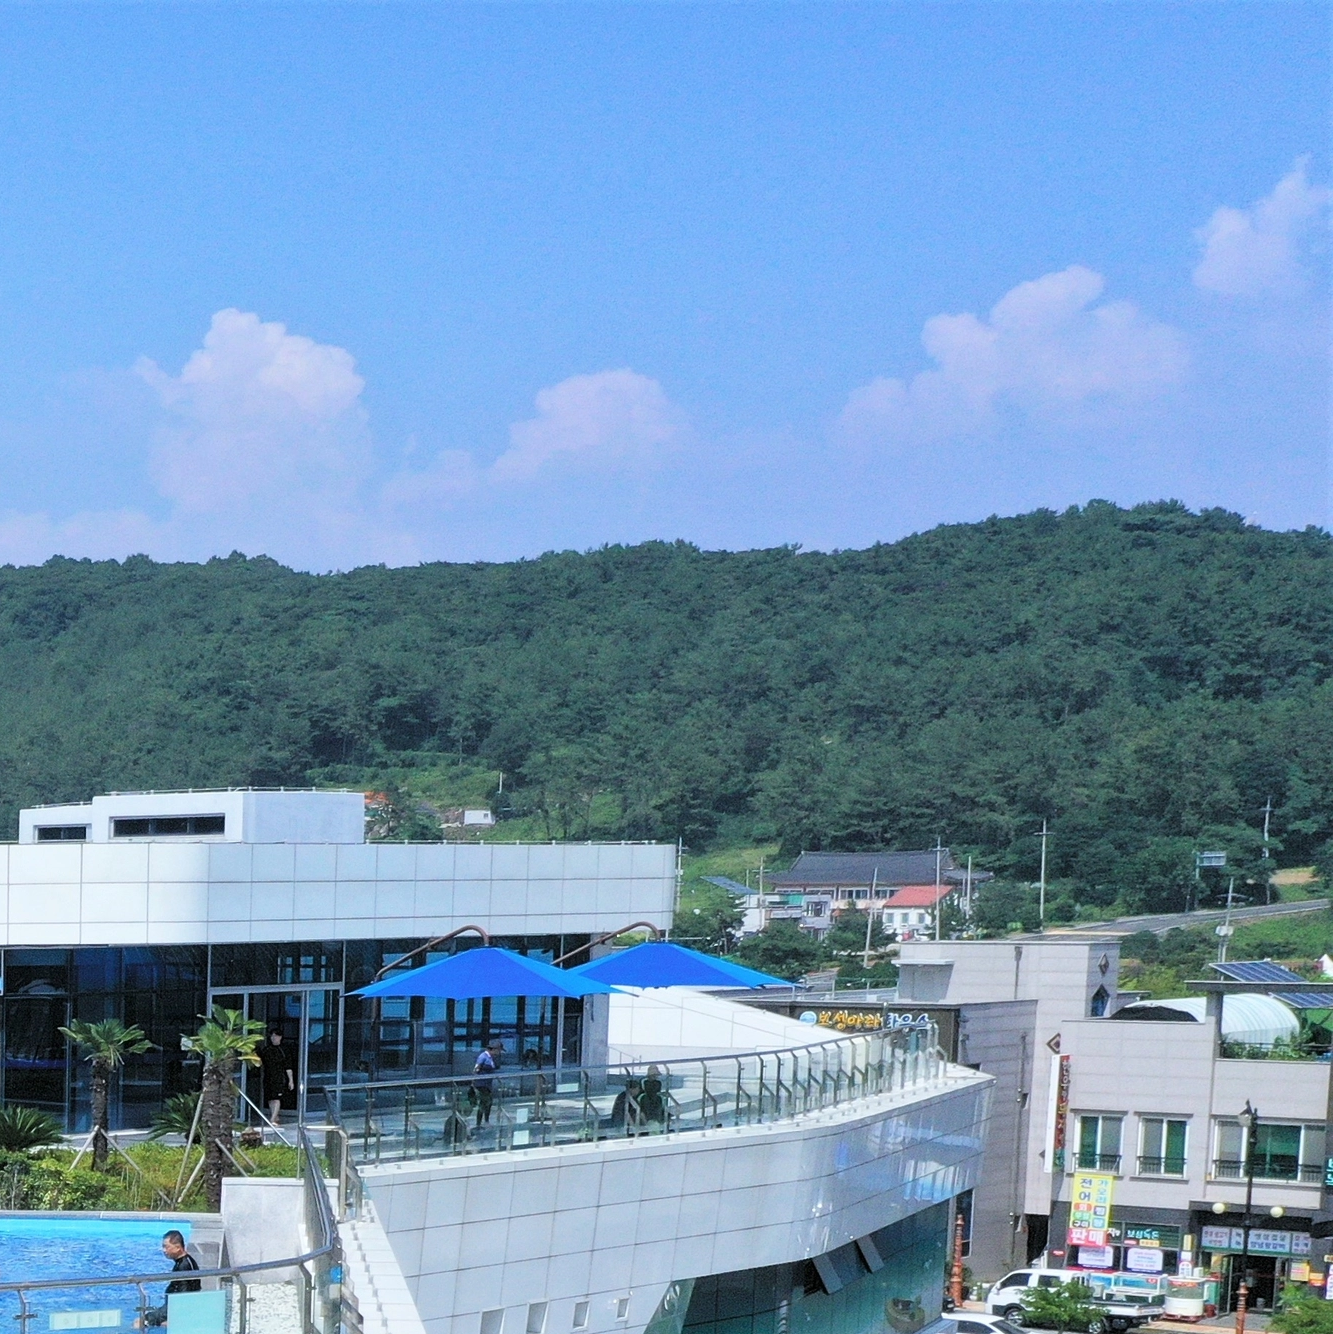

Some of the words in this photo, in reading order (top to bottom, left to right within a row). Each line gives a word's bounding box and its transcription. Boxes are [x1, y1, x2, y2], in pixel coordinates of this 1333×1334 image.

[1078, 1178, 1093, 1202] 전어
[1095, 1179, 1109, 1204] 가오리
[1070, 1229, 1105, 1246] 판매
